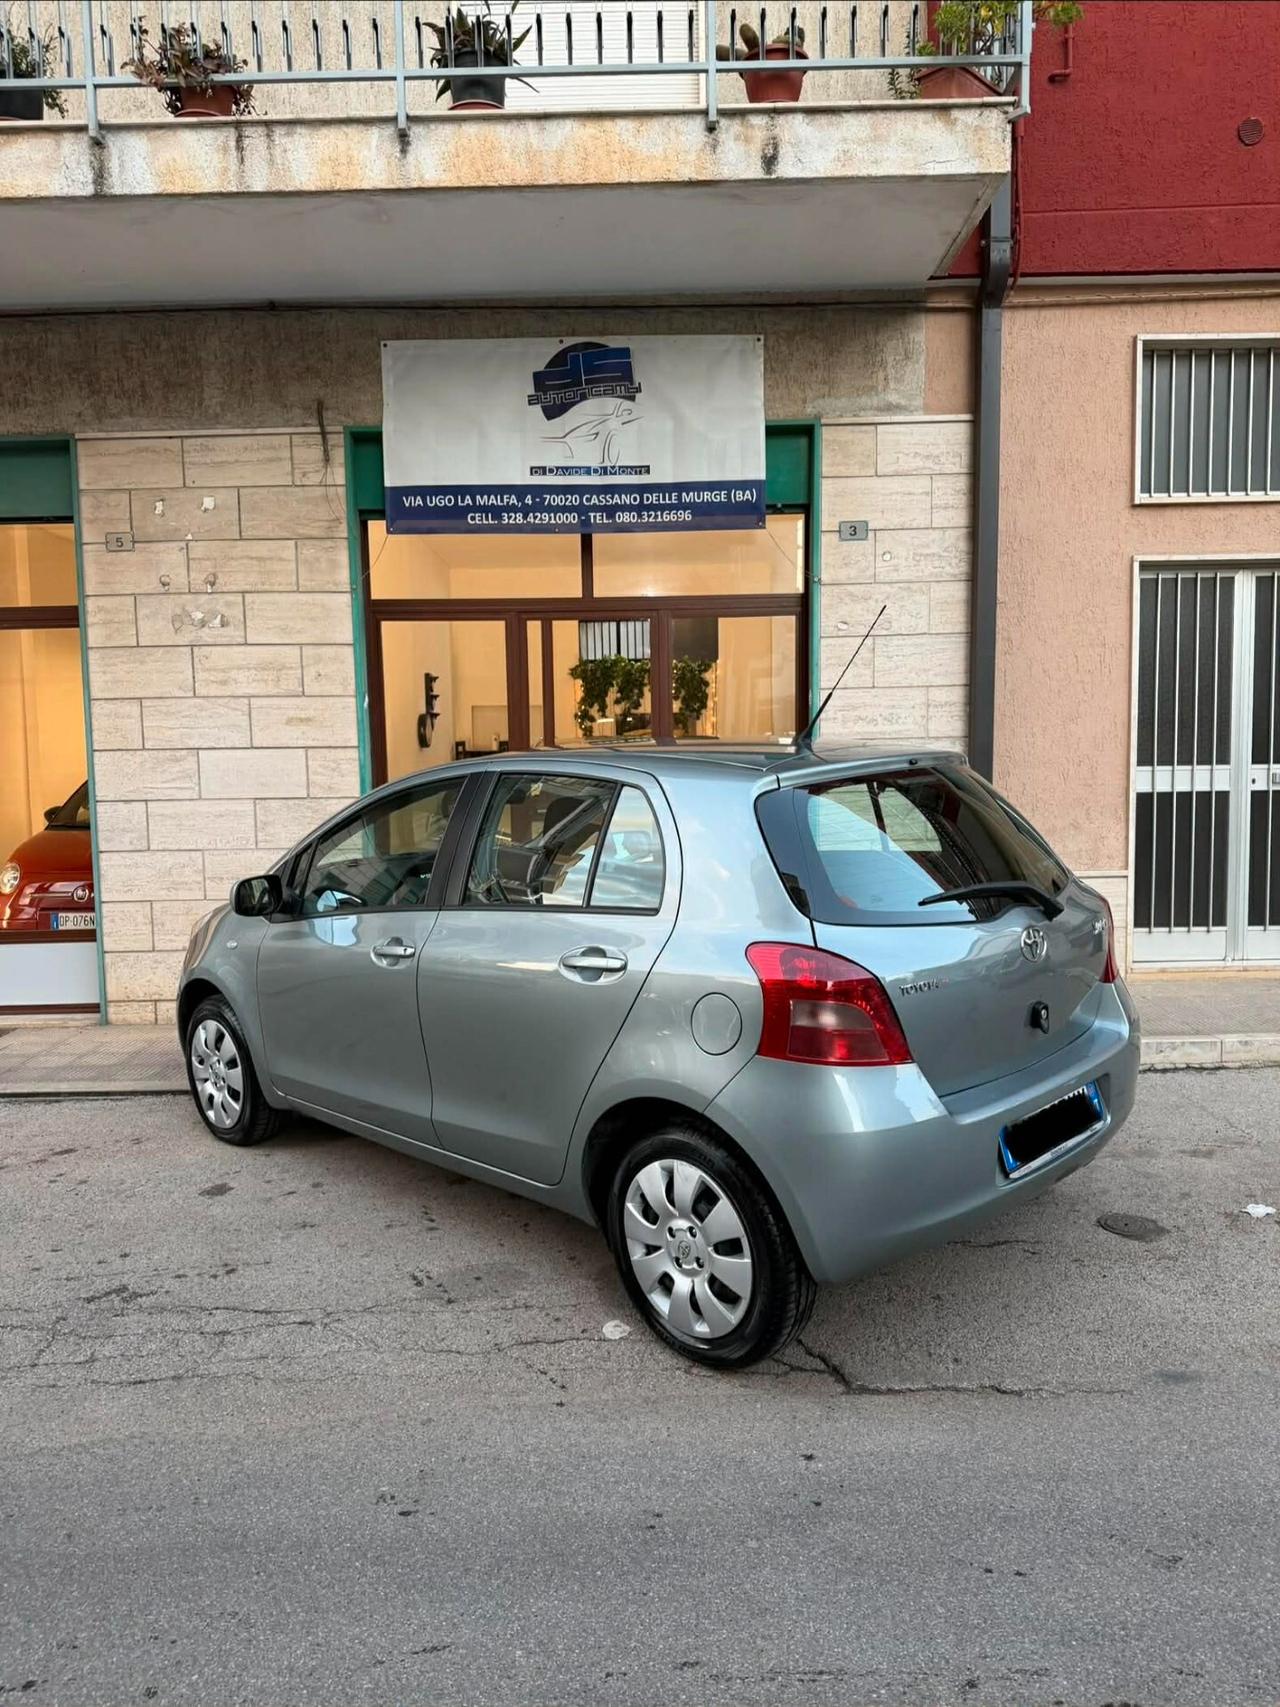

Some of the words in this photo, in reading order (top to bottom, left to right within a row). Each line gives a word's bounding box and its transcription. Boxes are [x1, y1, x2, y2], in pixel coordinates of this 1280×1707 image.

[403, 495, 424, 507] VIA
[427, 495, 455, 507] UGO
[458, 494, 473, 506] LA
[476, 494, 522, 508] MALFA,
[524, 494, 533, 506] 4
[543, 494, 580, 506] 70020
[583, 493, 640, 506] CASSANO
[643, 491, 678, 505] DELLE
[681, 490, 728, 504] MURGE
[731, 488, 757, 503] (BA)
[467, 513, 498, 524] CELL.
[501, 512, 578, 524] 328.4291000
[588, 512, 613, 524] TEL.
[615, 510, 692, 523] 080.3216696
[849, 525, 858, 537] 3
[115, 537, 124, 548] 5
